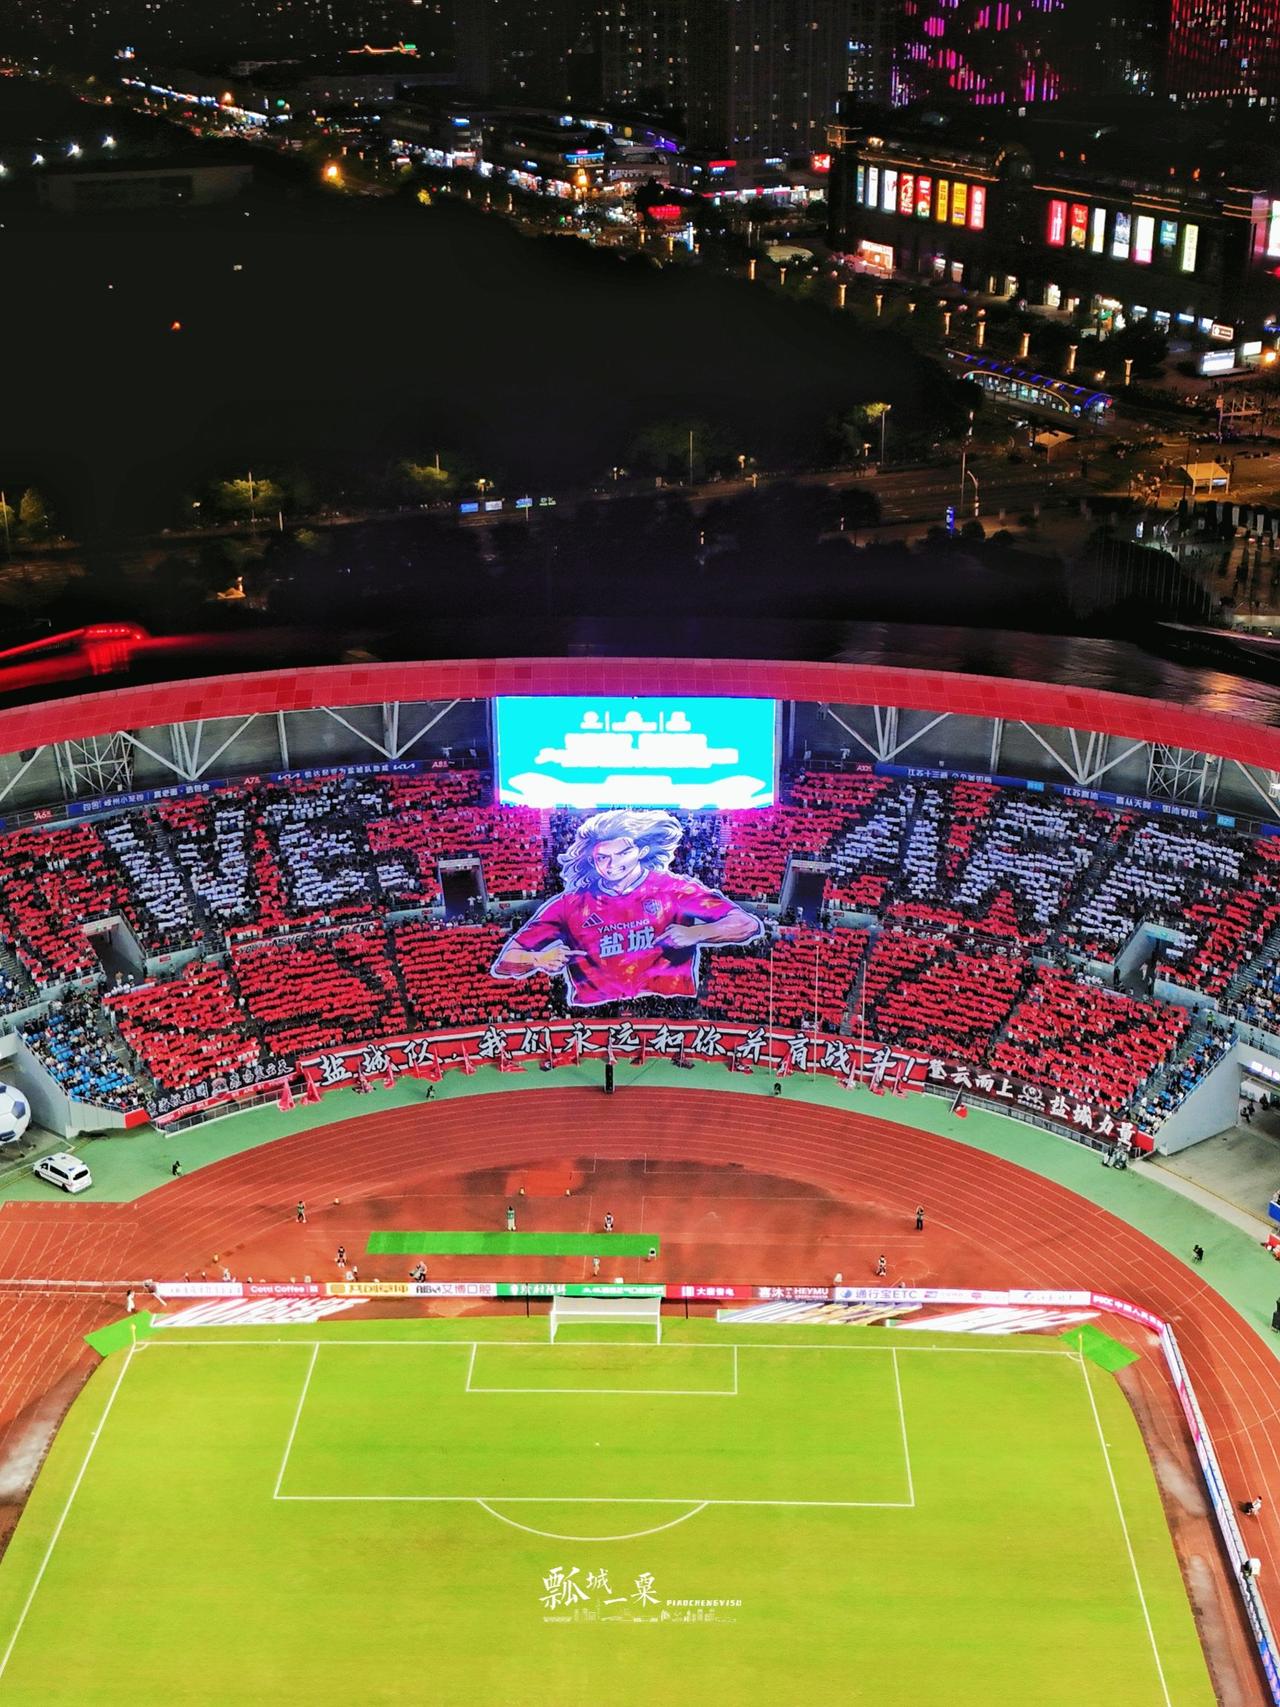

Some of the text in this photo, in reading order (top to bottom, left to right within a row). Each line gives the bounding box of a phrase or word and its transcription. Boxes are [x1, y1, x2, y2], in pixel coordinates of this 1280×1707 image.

[597, 918, 651, 934] YANCHENG
[599, 926, 655, 958] 盐城
[1049, 1095, 1137, 1151] 盐城力量
[275, 1285, 305, 1294] Coffee
[794, 1287, 829, 1296] HEYMU
